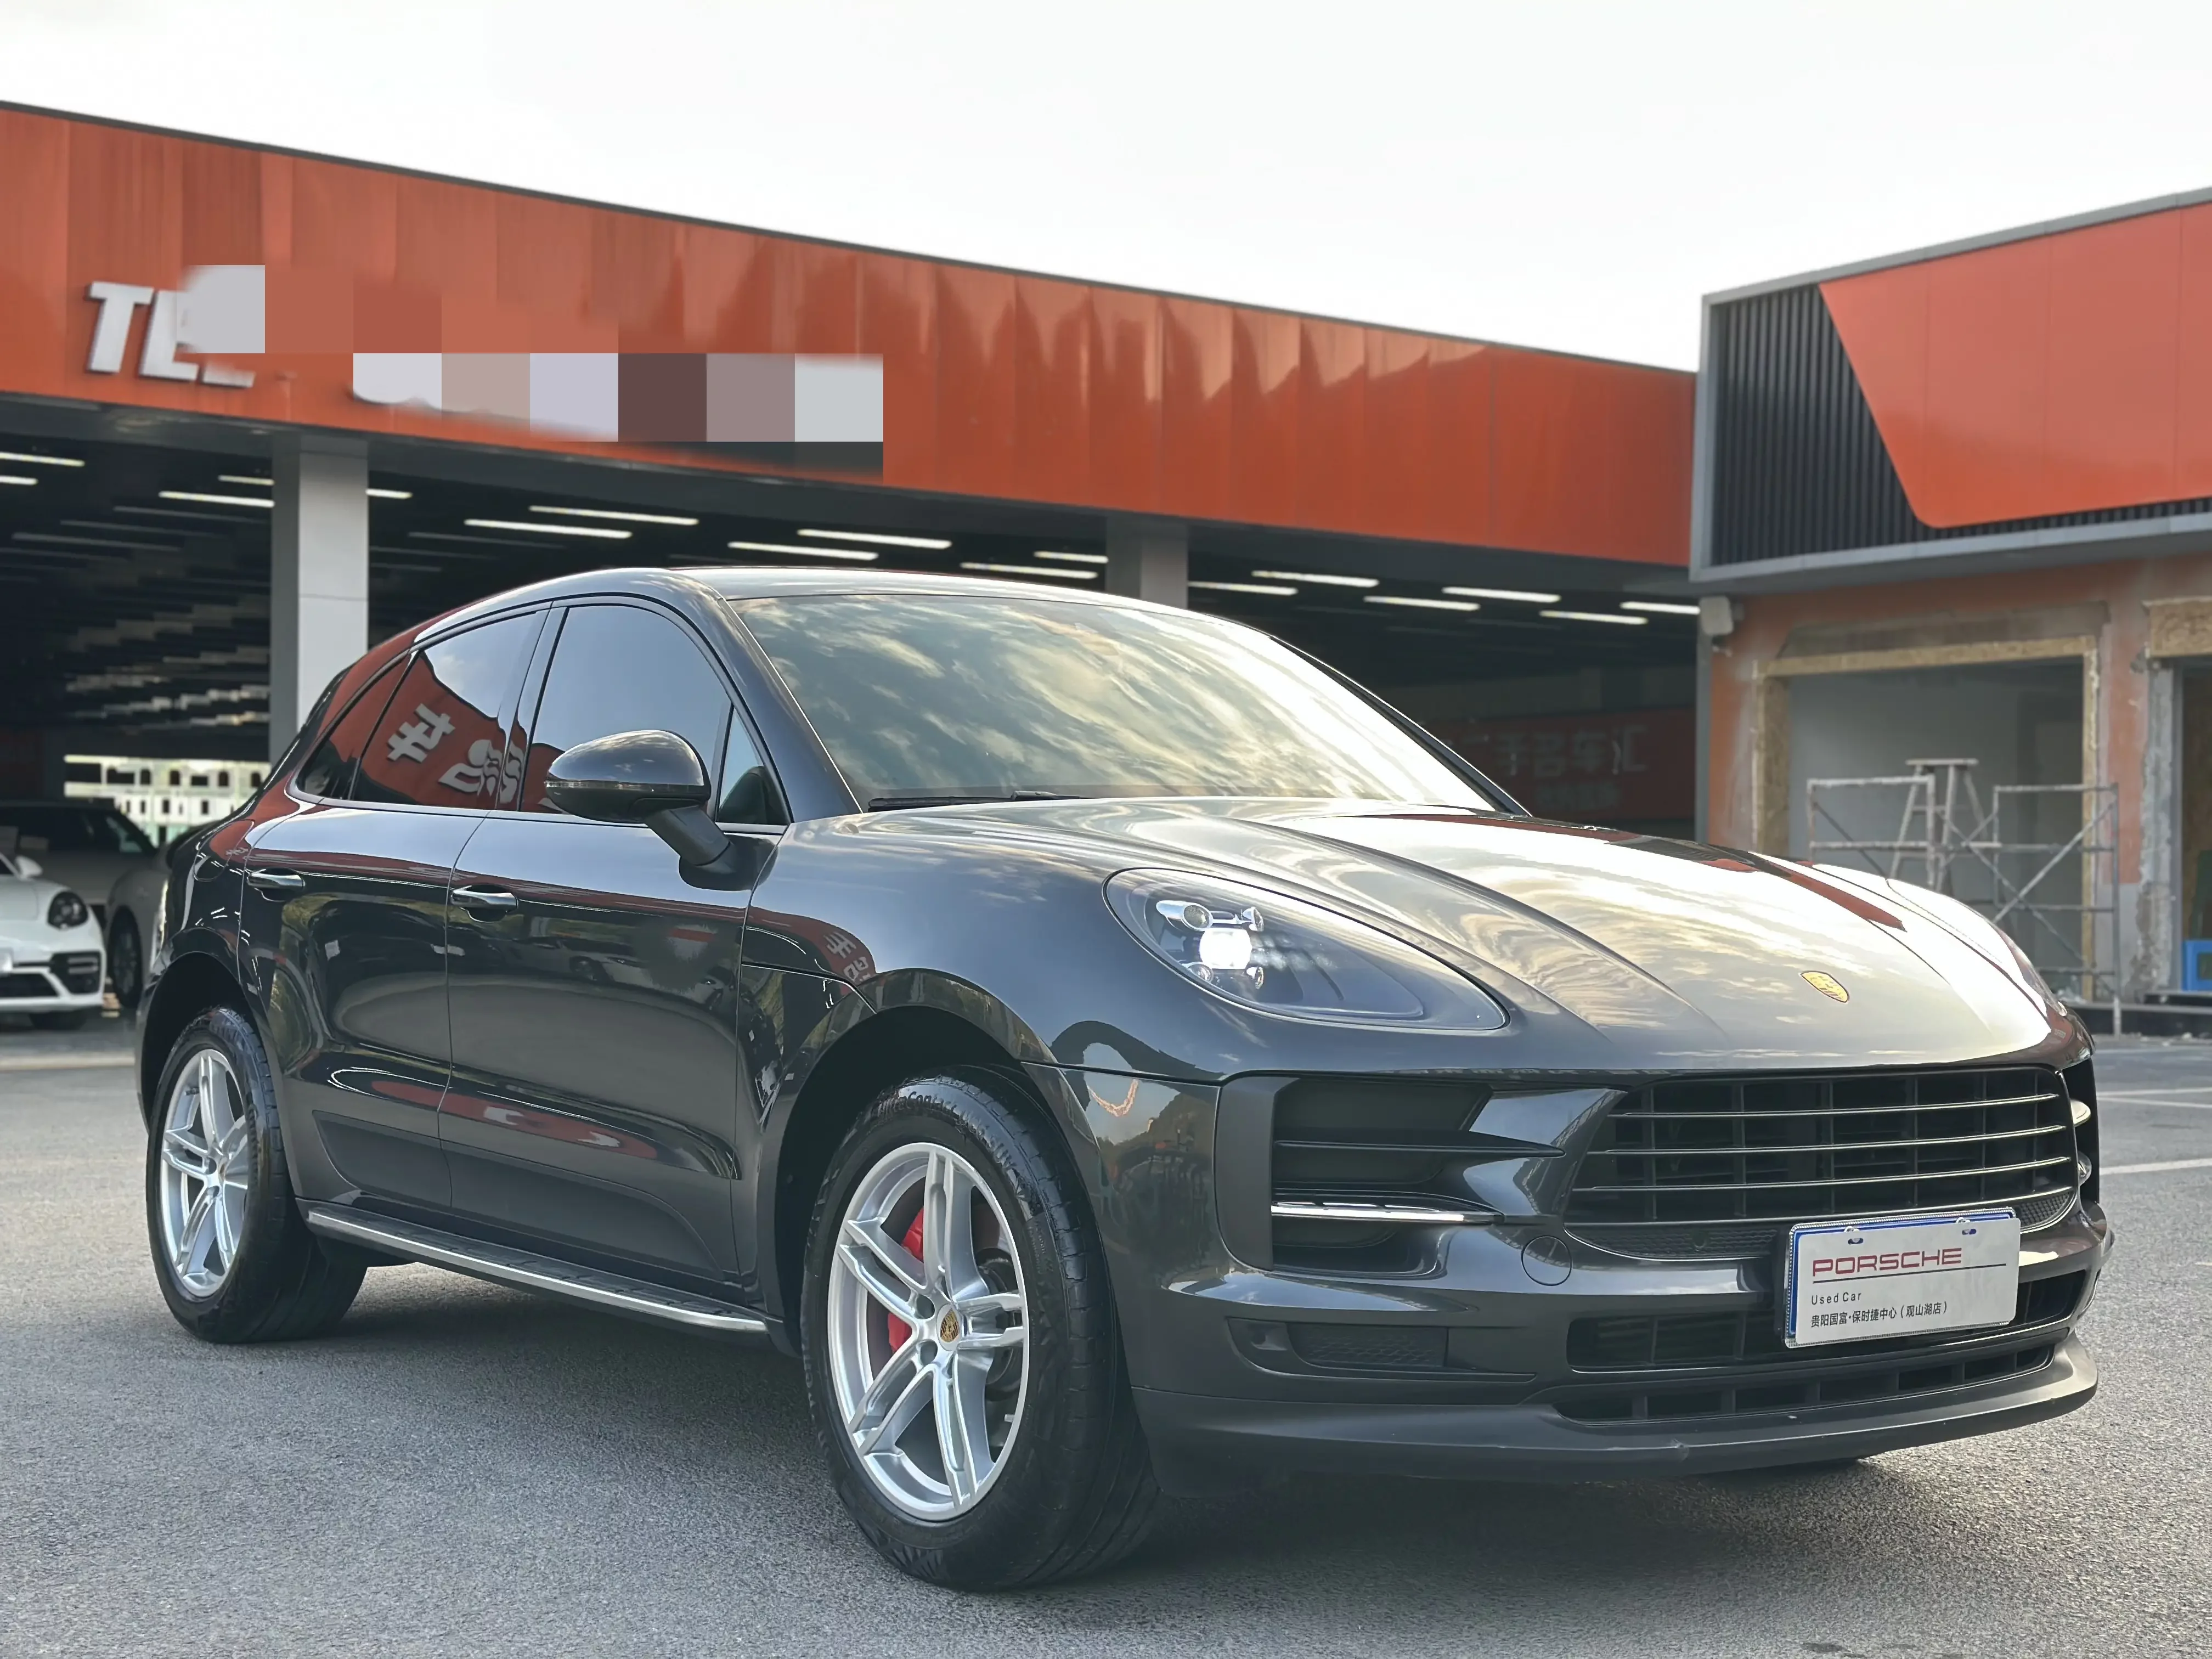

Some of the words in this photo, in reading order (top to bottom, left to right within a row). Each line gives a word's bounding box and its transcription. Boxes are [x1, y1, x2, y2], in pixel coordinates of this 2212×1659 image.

[1812, 1248, 1962, 1277] PORSCHE
[1811, 1293, 1839, 1305] Used
[1842, 1291, 1862, 1302] Car
